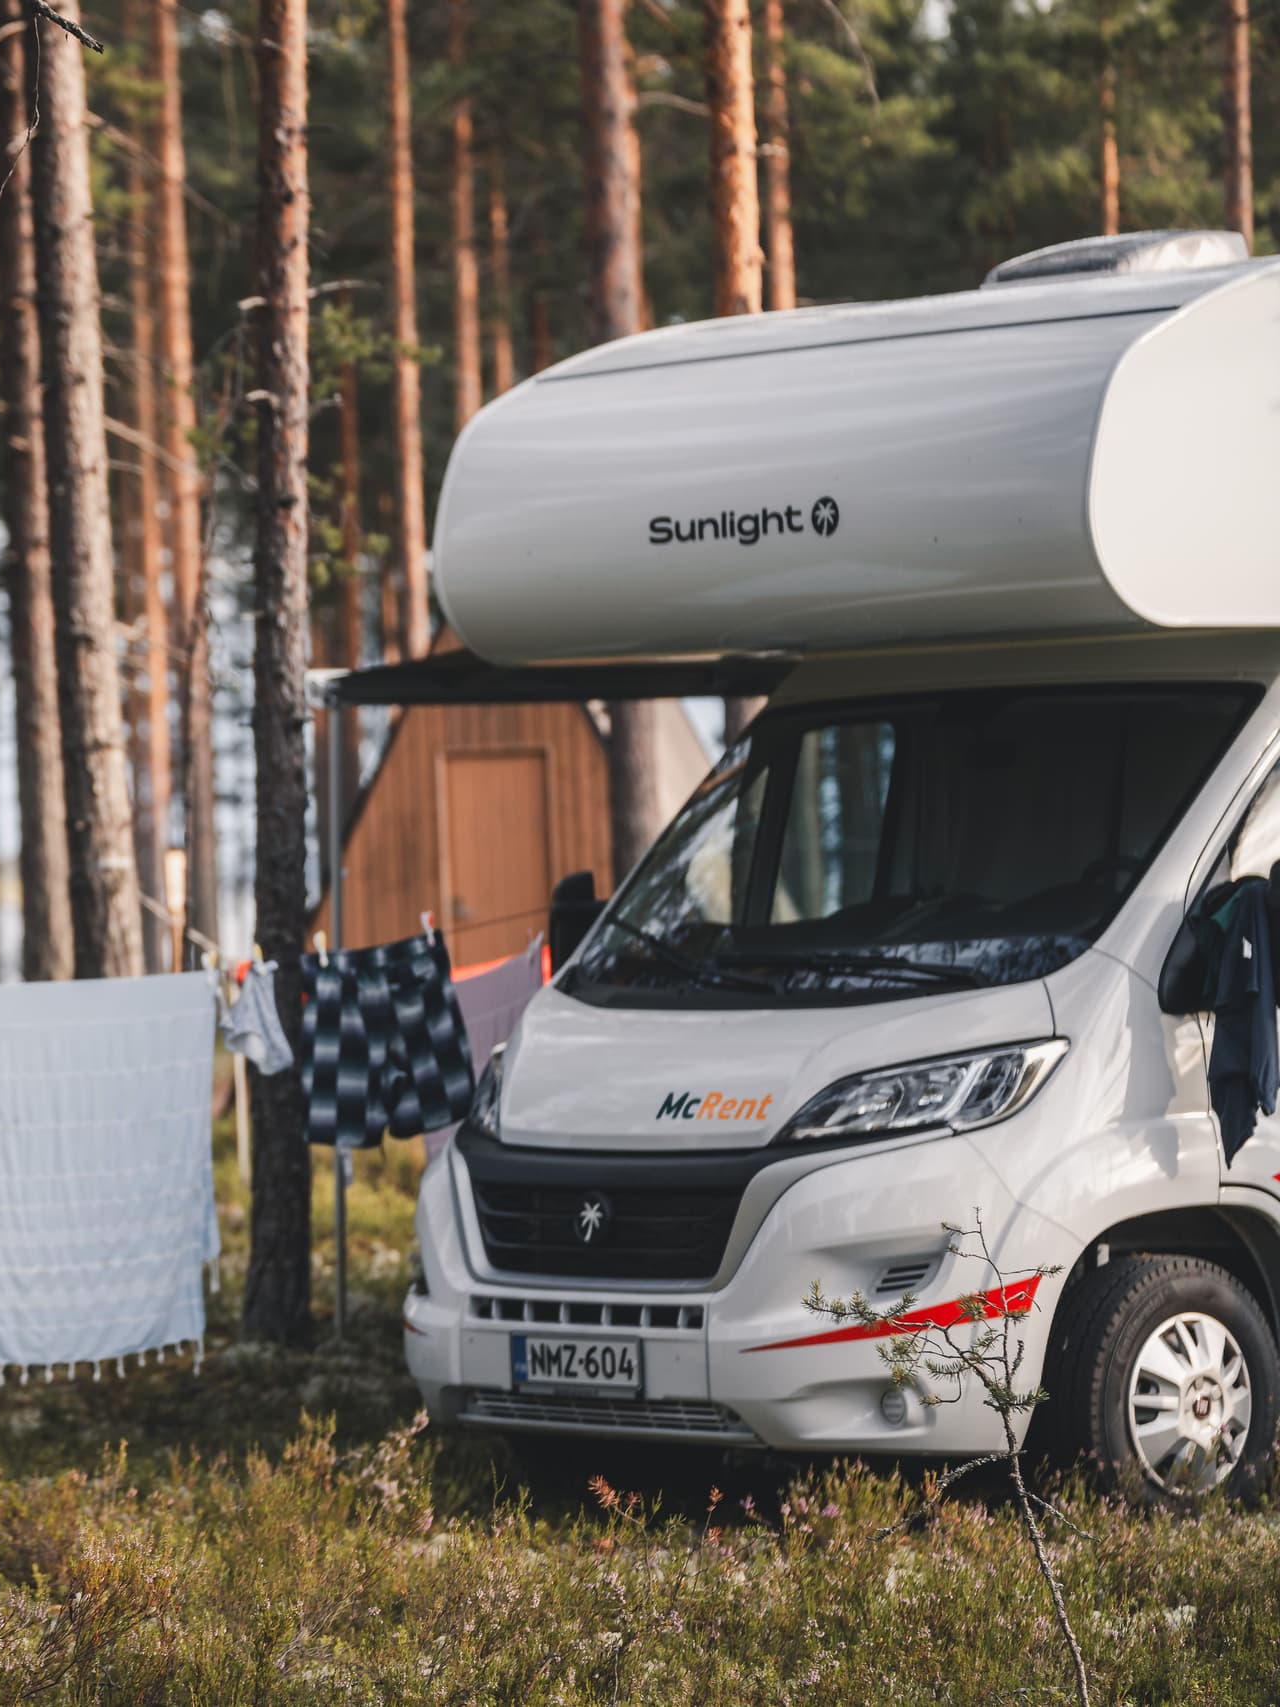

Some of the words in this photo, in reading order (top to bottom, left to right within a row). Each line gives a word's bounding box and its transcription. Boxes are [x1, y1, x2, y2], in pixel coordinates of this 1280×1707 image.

[649, 505, 804, 545] Sunlight
[656, 1091, 774, 1120] McRent
[530, 1343, 634, 1380] NMZ-604
